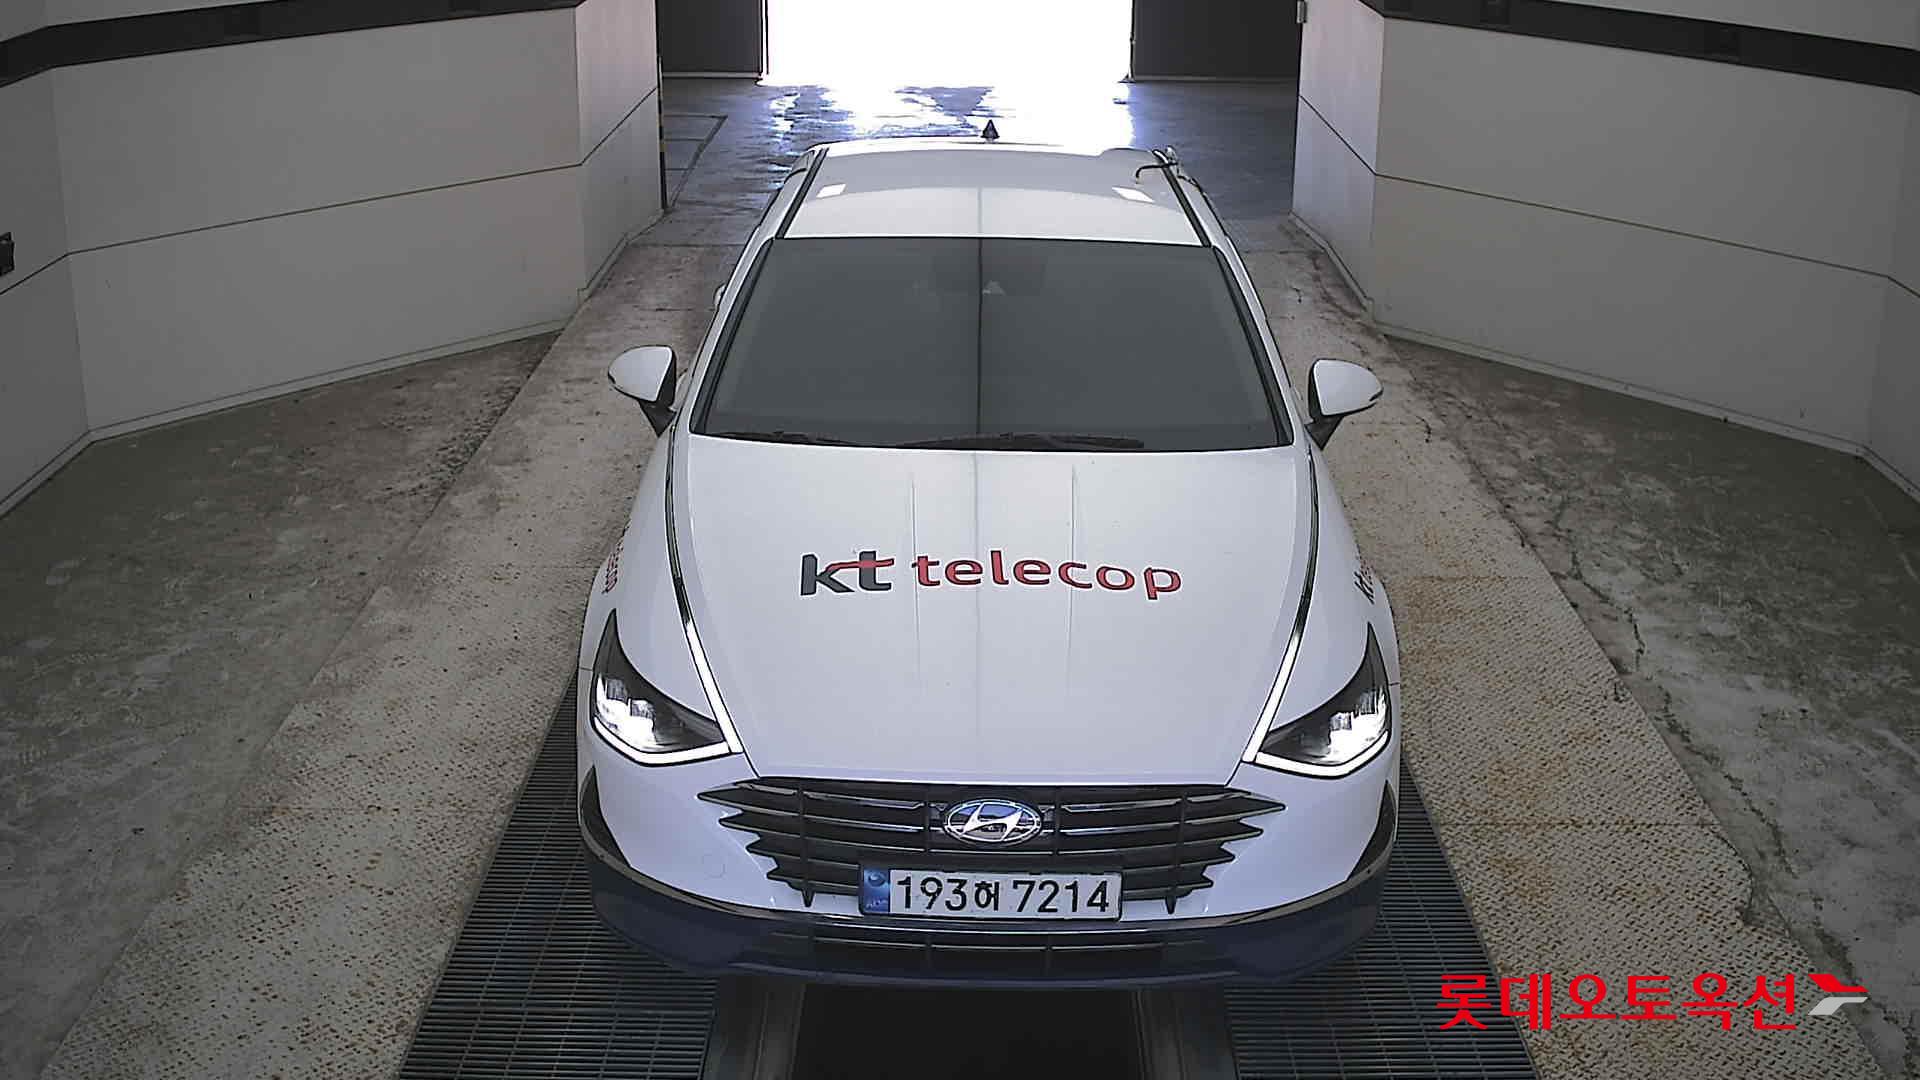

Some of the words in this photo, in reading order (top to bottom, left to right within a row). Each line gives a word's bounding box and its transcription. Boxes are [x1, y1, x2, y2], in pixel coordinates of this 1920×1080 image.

[800, 550, 895, 596] kt
[911, 550, 1182, 600] telecop
[897, 876, 1000, 912] 193허
[1012, 880, 1110, 913] 7214
